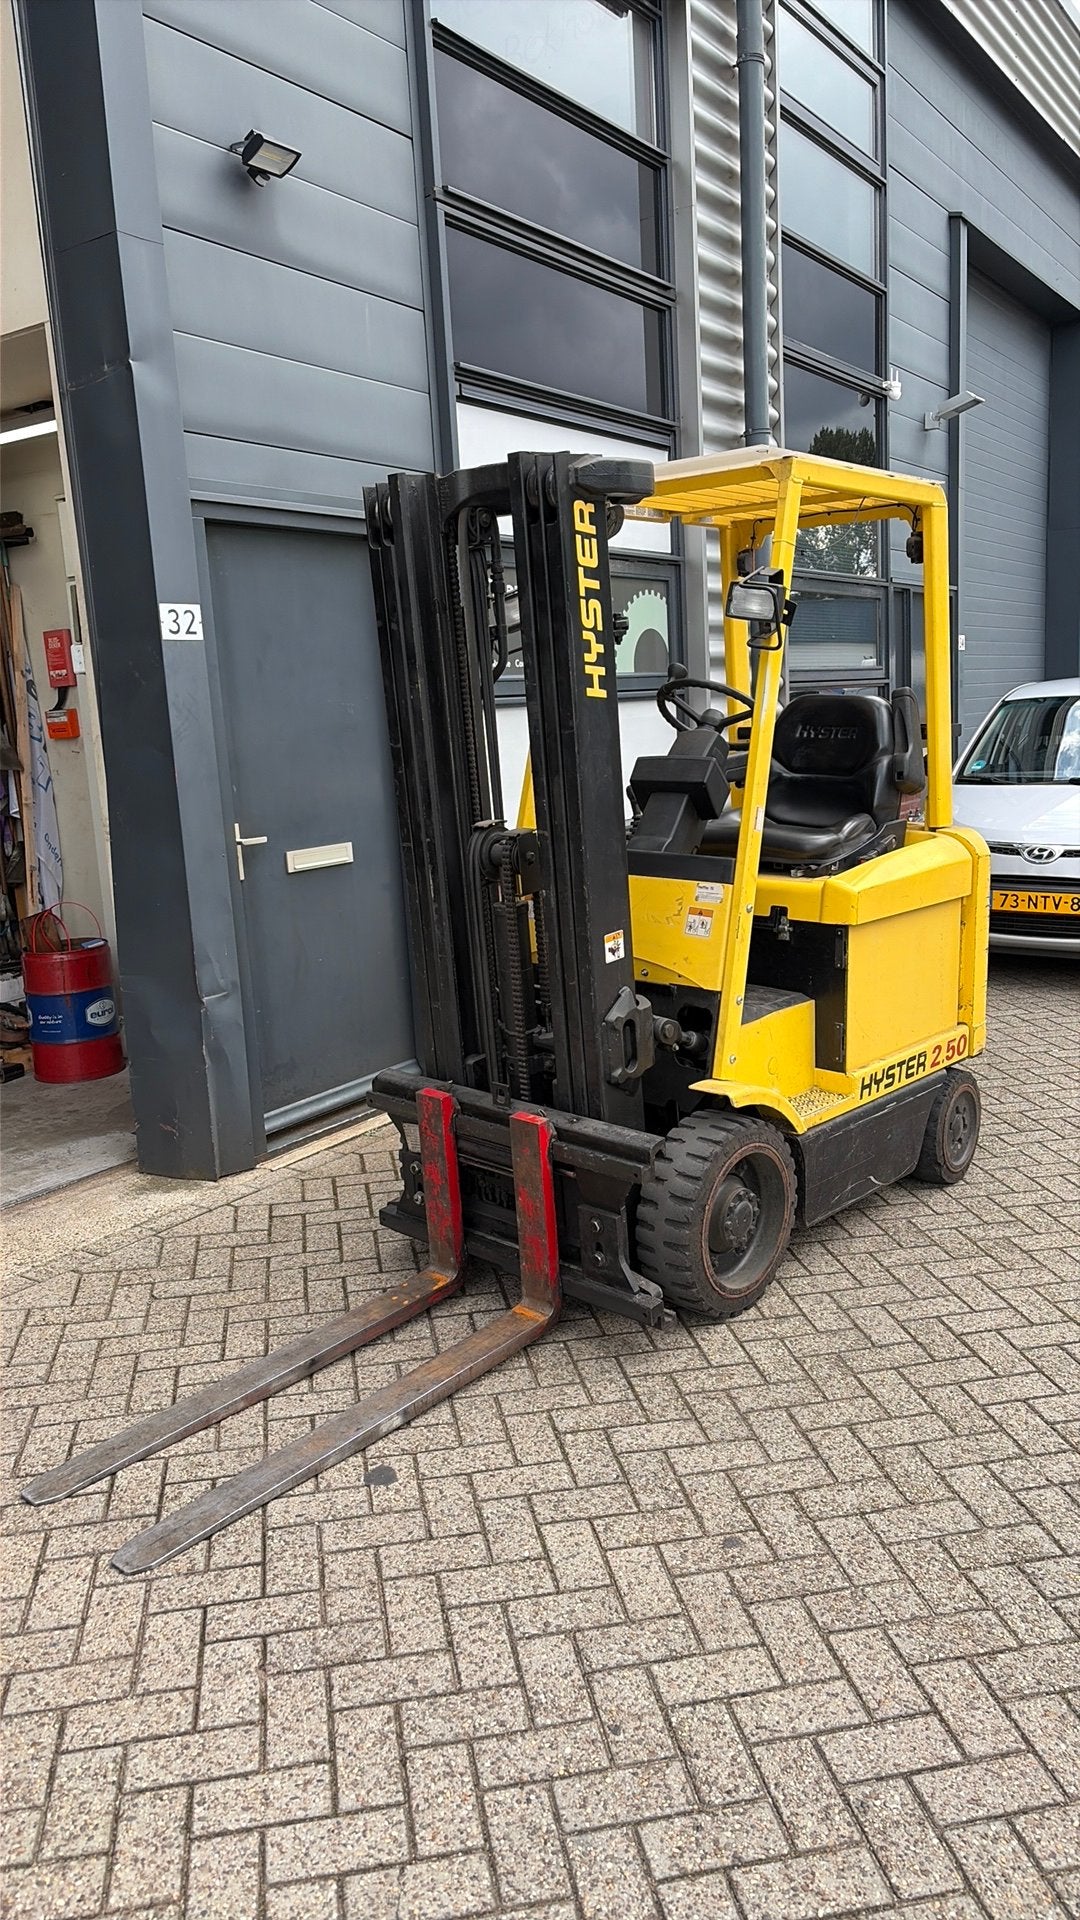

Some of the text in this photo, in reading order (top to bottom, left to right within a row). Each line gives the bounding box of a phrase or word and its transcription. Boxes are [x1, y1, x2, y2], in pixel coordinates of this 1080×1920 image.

[573, 499, 608, 699] HYSTER
[167, 608, 198, 635] 32
[795, 725, 858, 739] HYSTER
[999, 893, 1080, 912] 73-NTV-8
[859, 1034, 967, 1100] HYSTER 2.50
